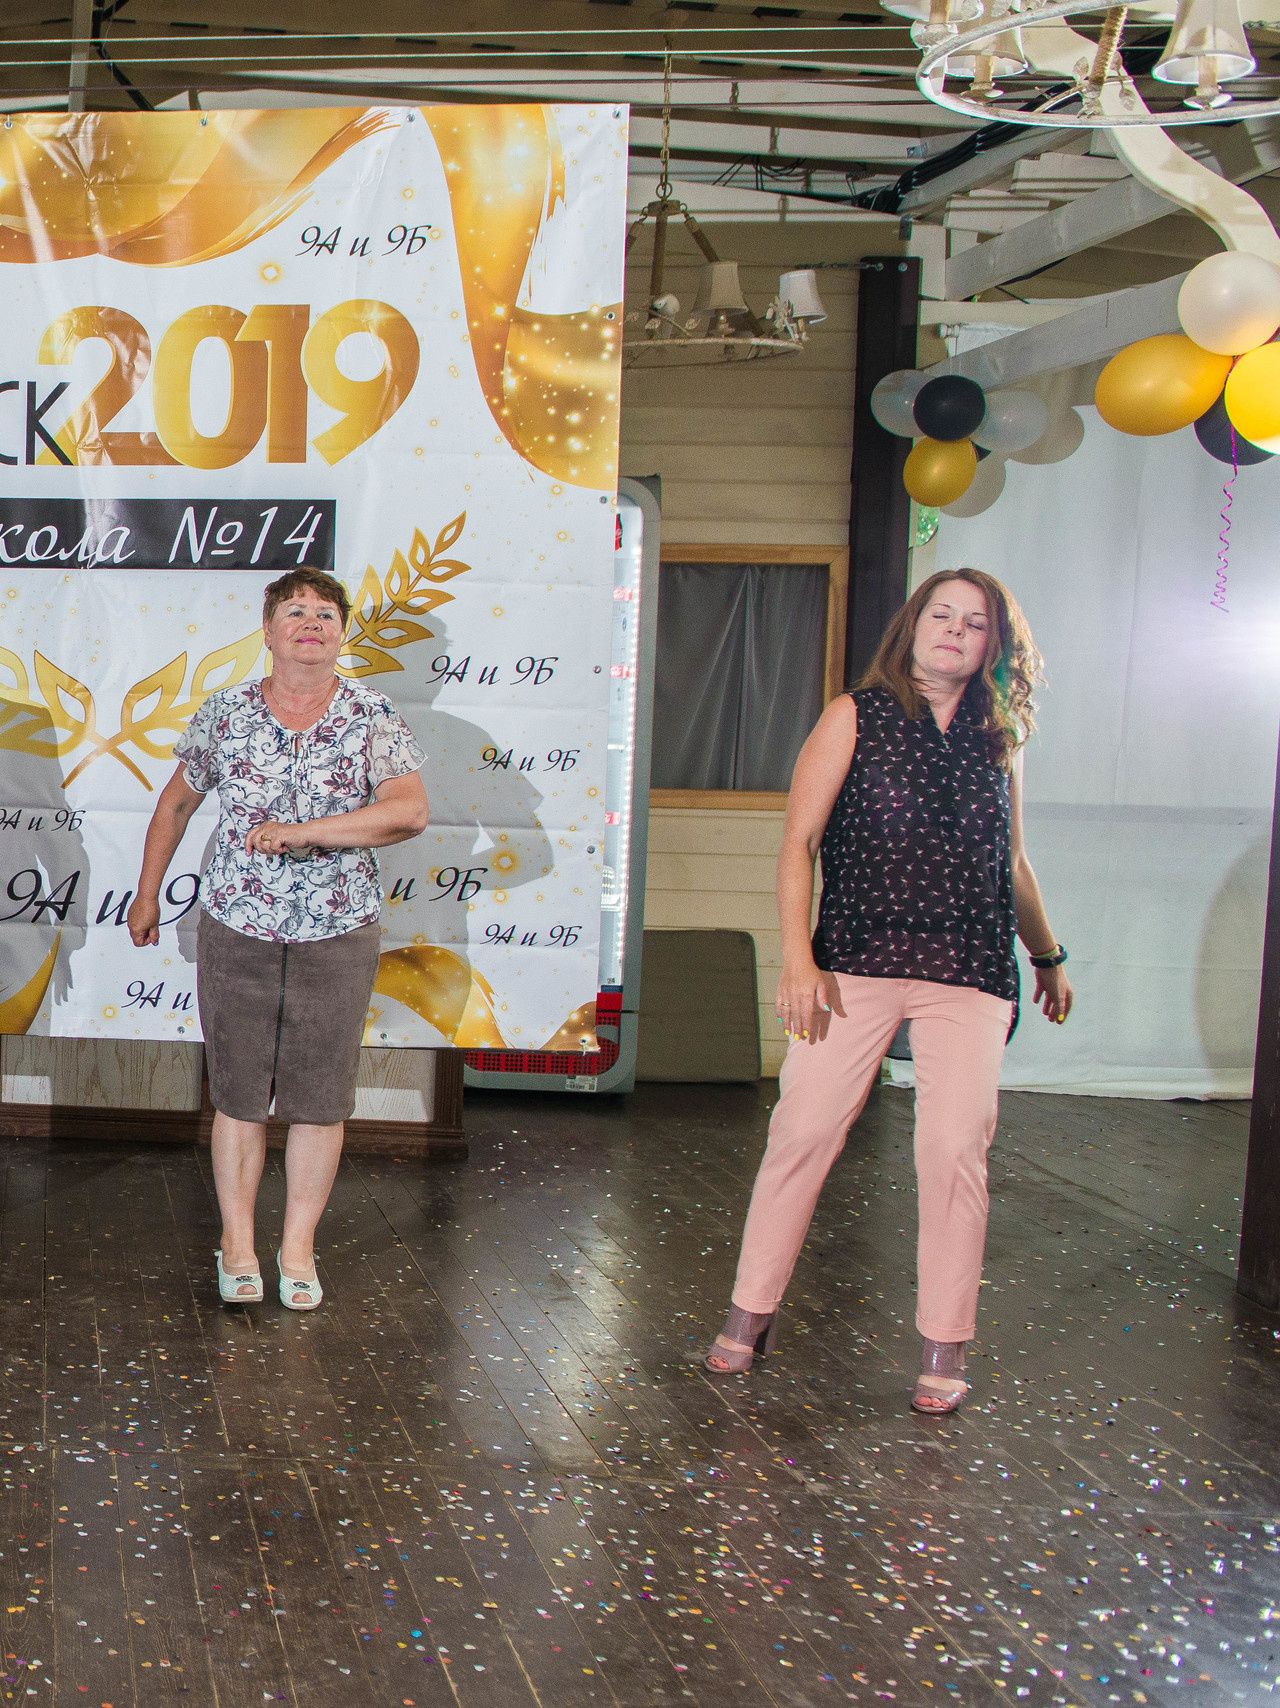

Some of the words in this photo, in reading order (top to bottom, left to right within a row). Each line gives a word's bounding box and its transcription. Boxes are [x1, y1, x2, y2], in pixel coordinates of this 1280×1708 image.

[295, 225, 343, 257] 9А
[348, 235, 371, 257] и
[381, 224, 431, 257] 9Б
[37, 299, 420, 470] 2019
[168, 505, 322, 564] №14
[425, 655, 471, 685] 9А
[478, 665, 501, 685] и
[510, 656, 559, 686] 9Б
[477, 748, 514, 772] 9А
[519, 757, 536, 772] и
[542, 748, 581, 772] 9Б
[27, 817, 45, 832] и
[50, 809, 86, 832] 9Б
[389, 878, 418, 902] и
[428, 866, 488, 902] 9Б
[95, 890, 133, 927] и
[480, 923, 516, 946] 9А
[520, 932, 539, 946] и
[544, 924, 582, 947] 9Б
[121, 980, 165, 1009] 9А
[172, 992, 194, 1011] и
